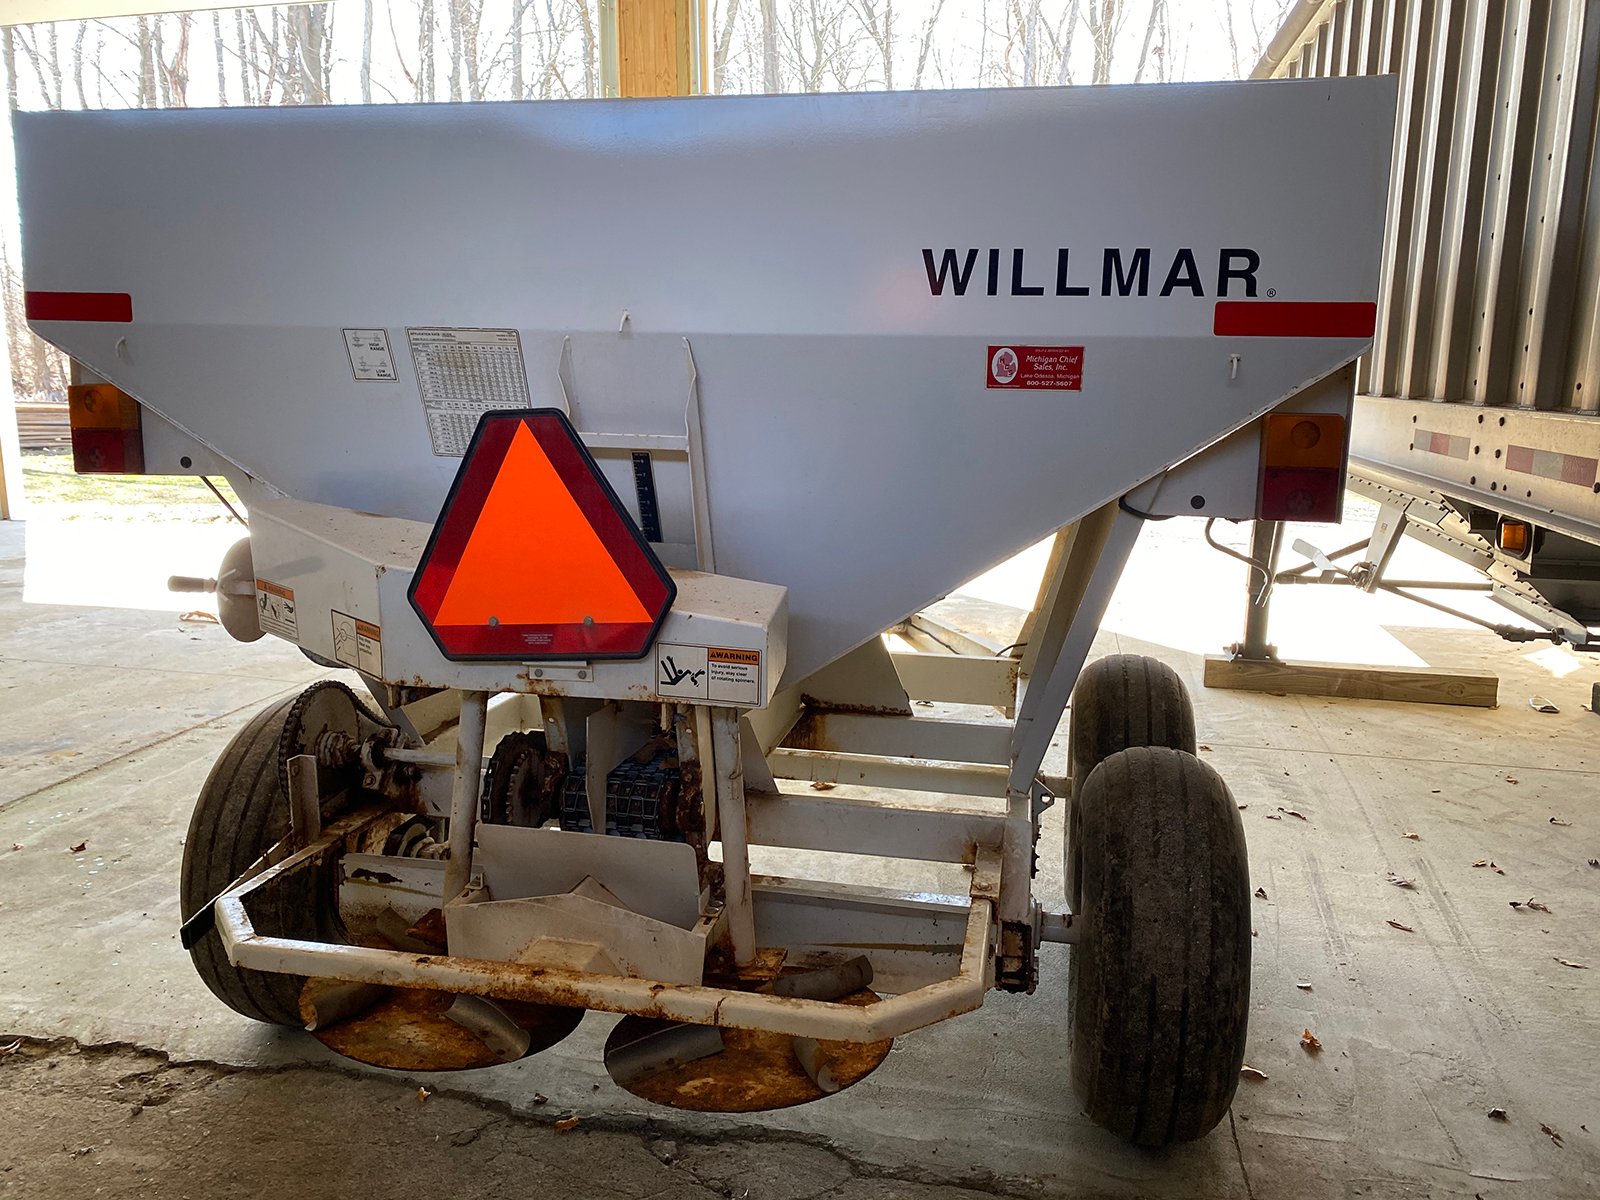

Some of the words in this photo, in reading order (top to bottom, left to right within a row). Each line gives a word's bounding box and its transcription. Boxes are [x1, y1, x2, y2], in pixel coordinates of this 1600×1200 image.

[921, 248, 1260, 297] WILLMAR
[1026, 355, 1057, 364] Michigan
[1060, 355, 1078, 364] Chief
[1034, 362, 1054, 371] Sales,
[716, 652, 758, 662] WARNING
